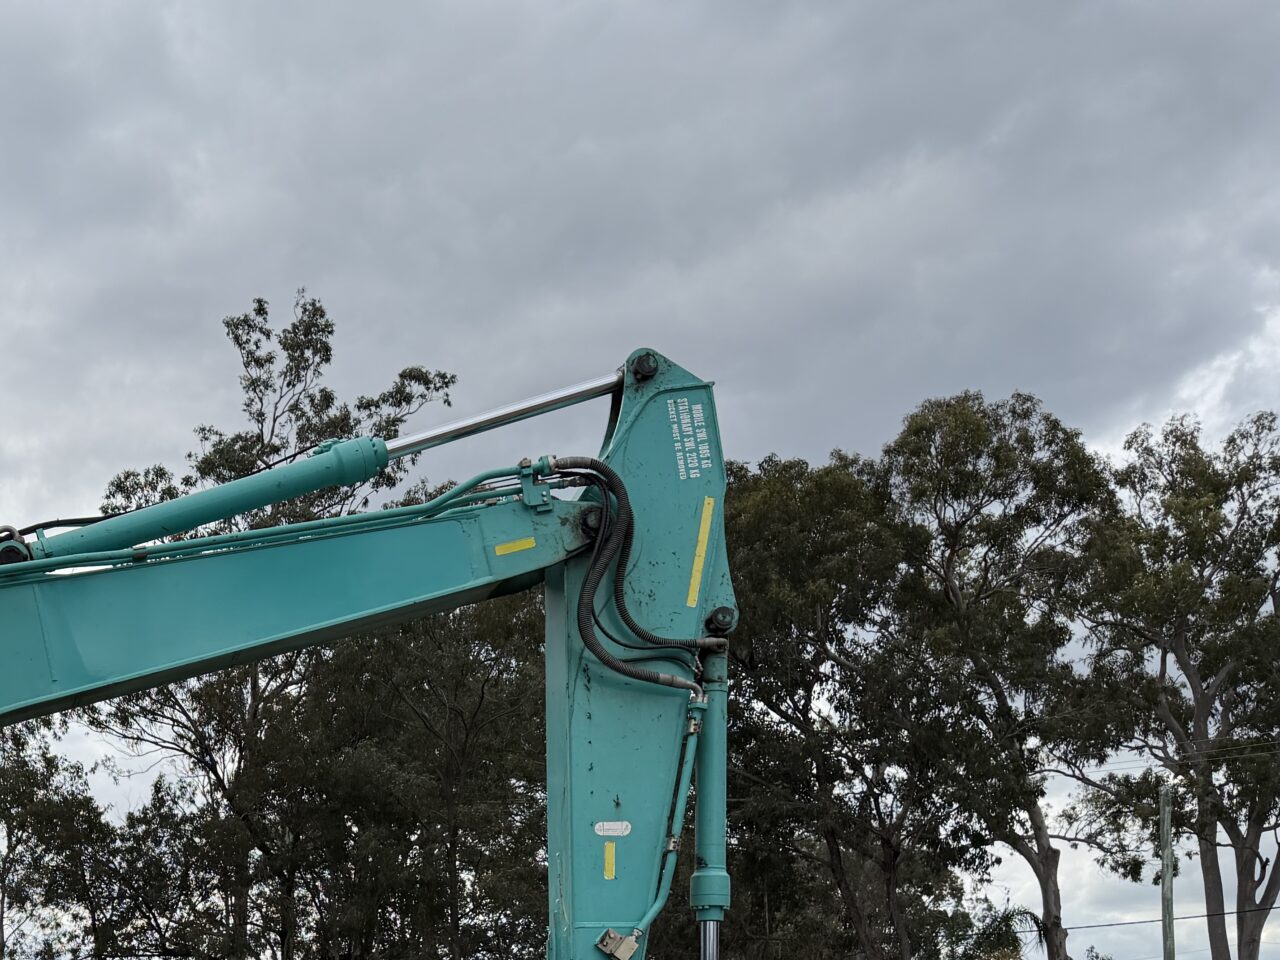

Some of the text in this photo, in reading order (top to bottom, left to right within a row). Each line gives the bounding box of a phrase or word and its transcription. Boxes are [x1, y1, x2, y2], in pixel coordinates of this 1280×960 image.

[678, 398, 693, 434] STATIONARY
[668, 400, 677, 421] BUCKET
[676, 452, 686, 480] REMOVED
[696, 429, 707, 441] SWL
[684, 438, 696, 451] SWL
[701, 459, 712, 468] KG
[690, 470, 700, 478] KG
